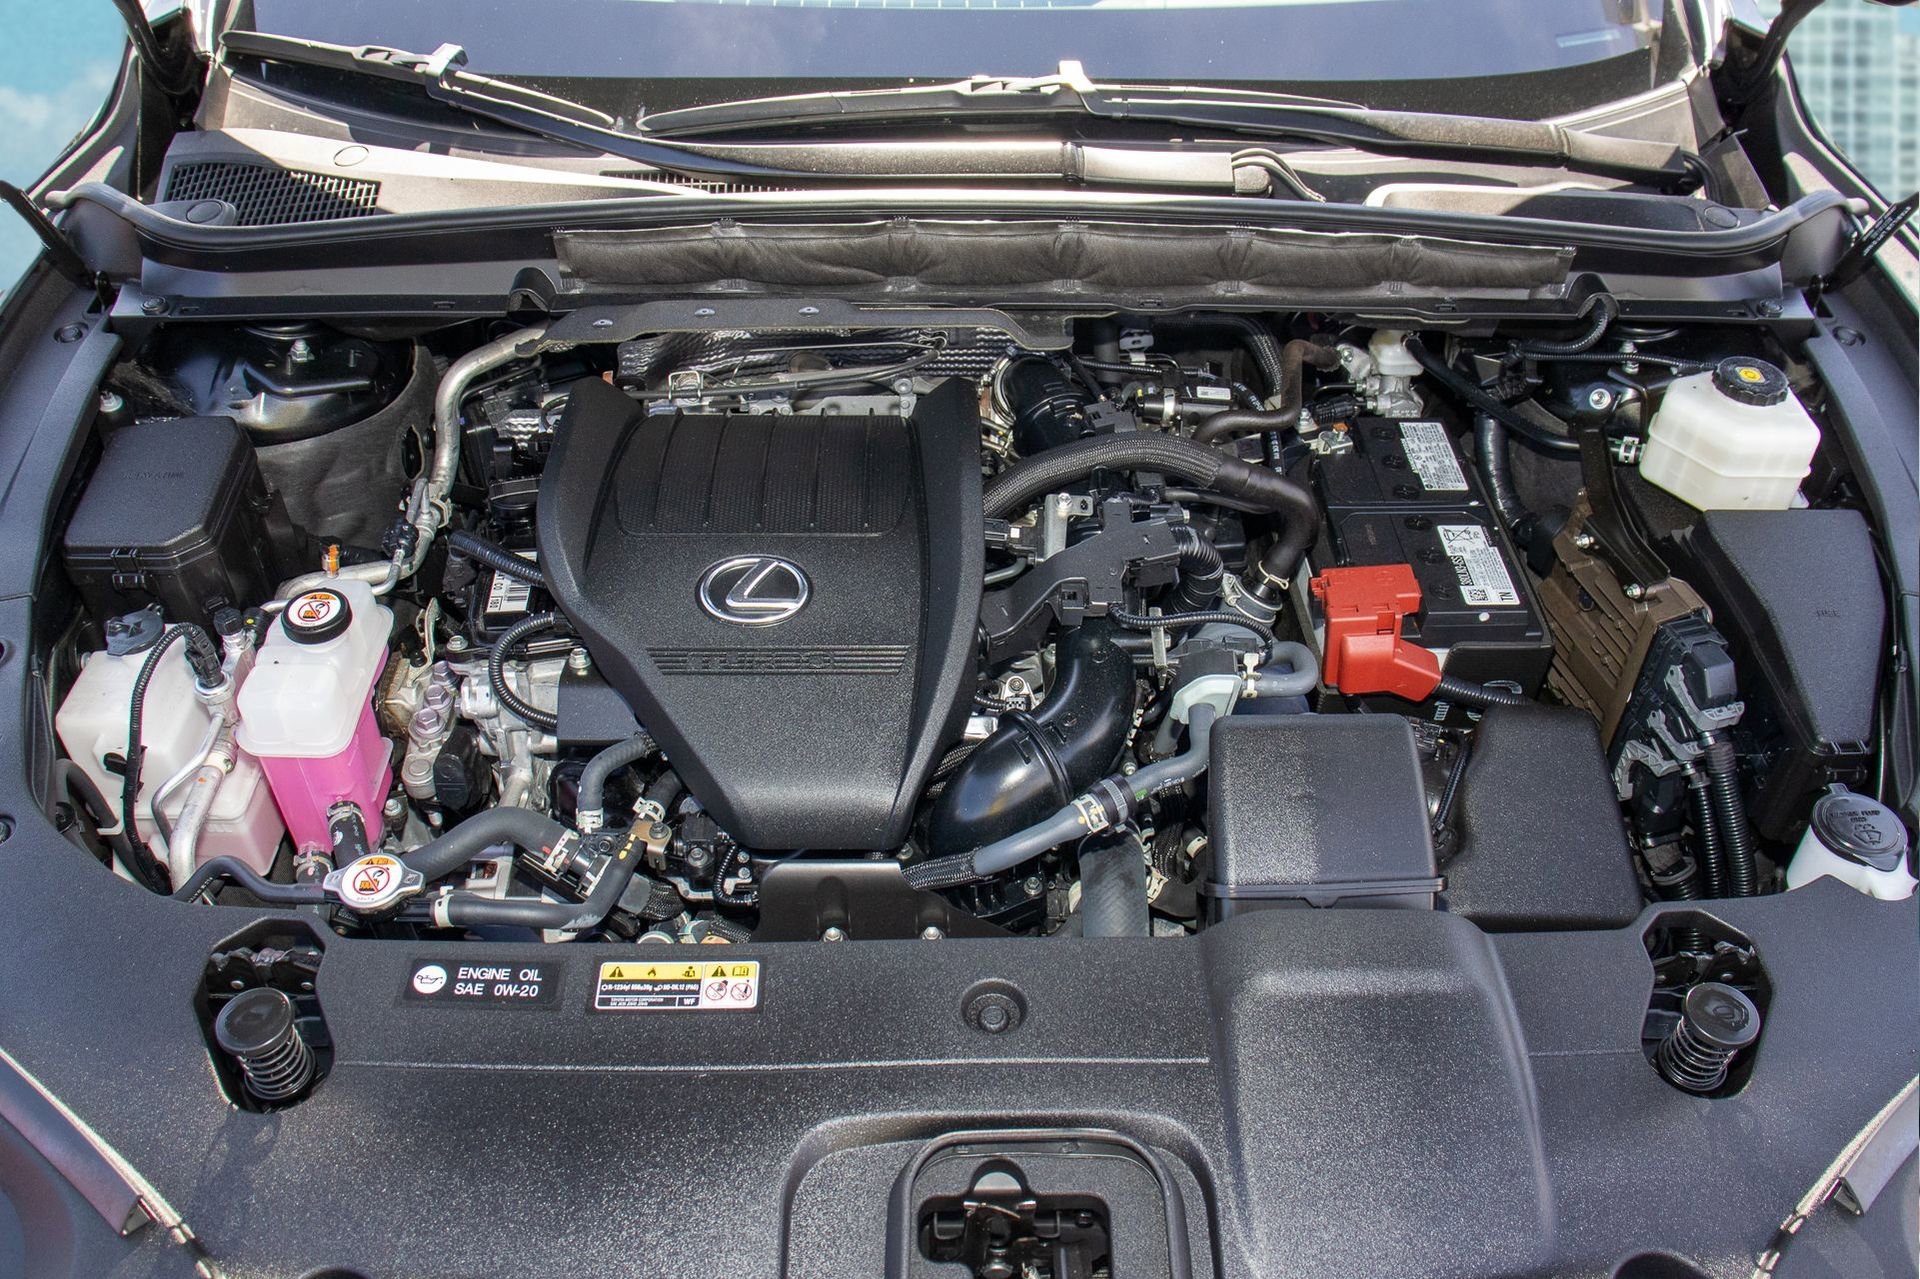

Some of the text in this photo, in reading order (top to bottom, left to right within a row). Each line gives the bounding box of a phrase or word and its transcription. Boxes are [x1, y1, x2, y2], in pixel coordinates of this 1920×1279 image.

[457, 967, 543, 982] ENGINE OIL
[454, 983, 539, 997] SAE 0W-20
